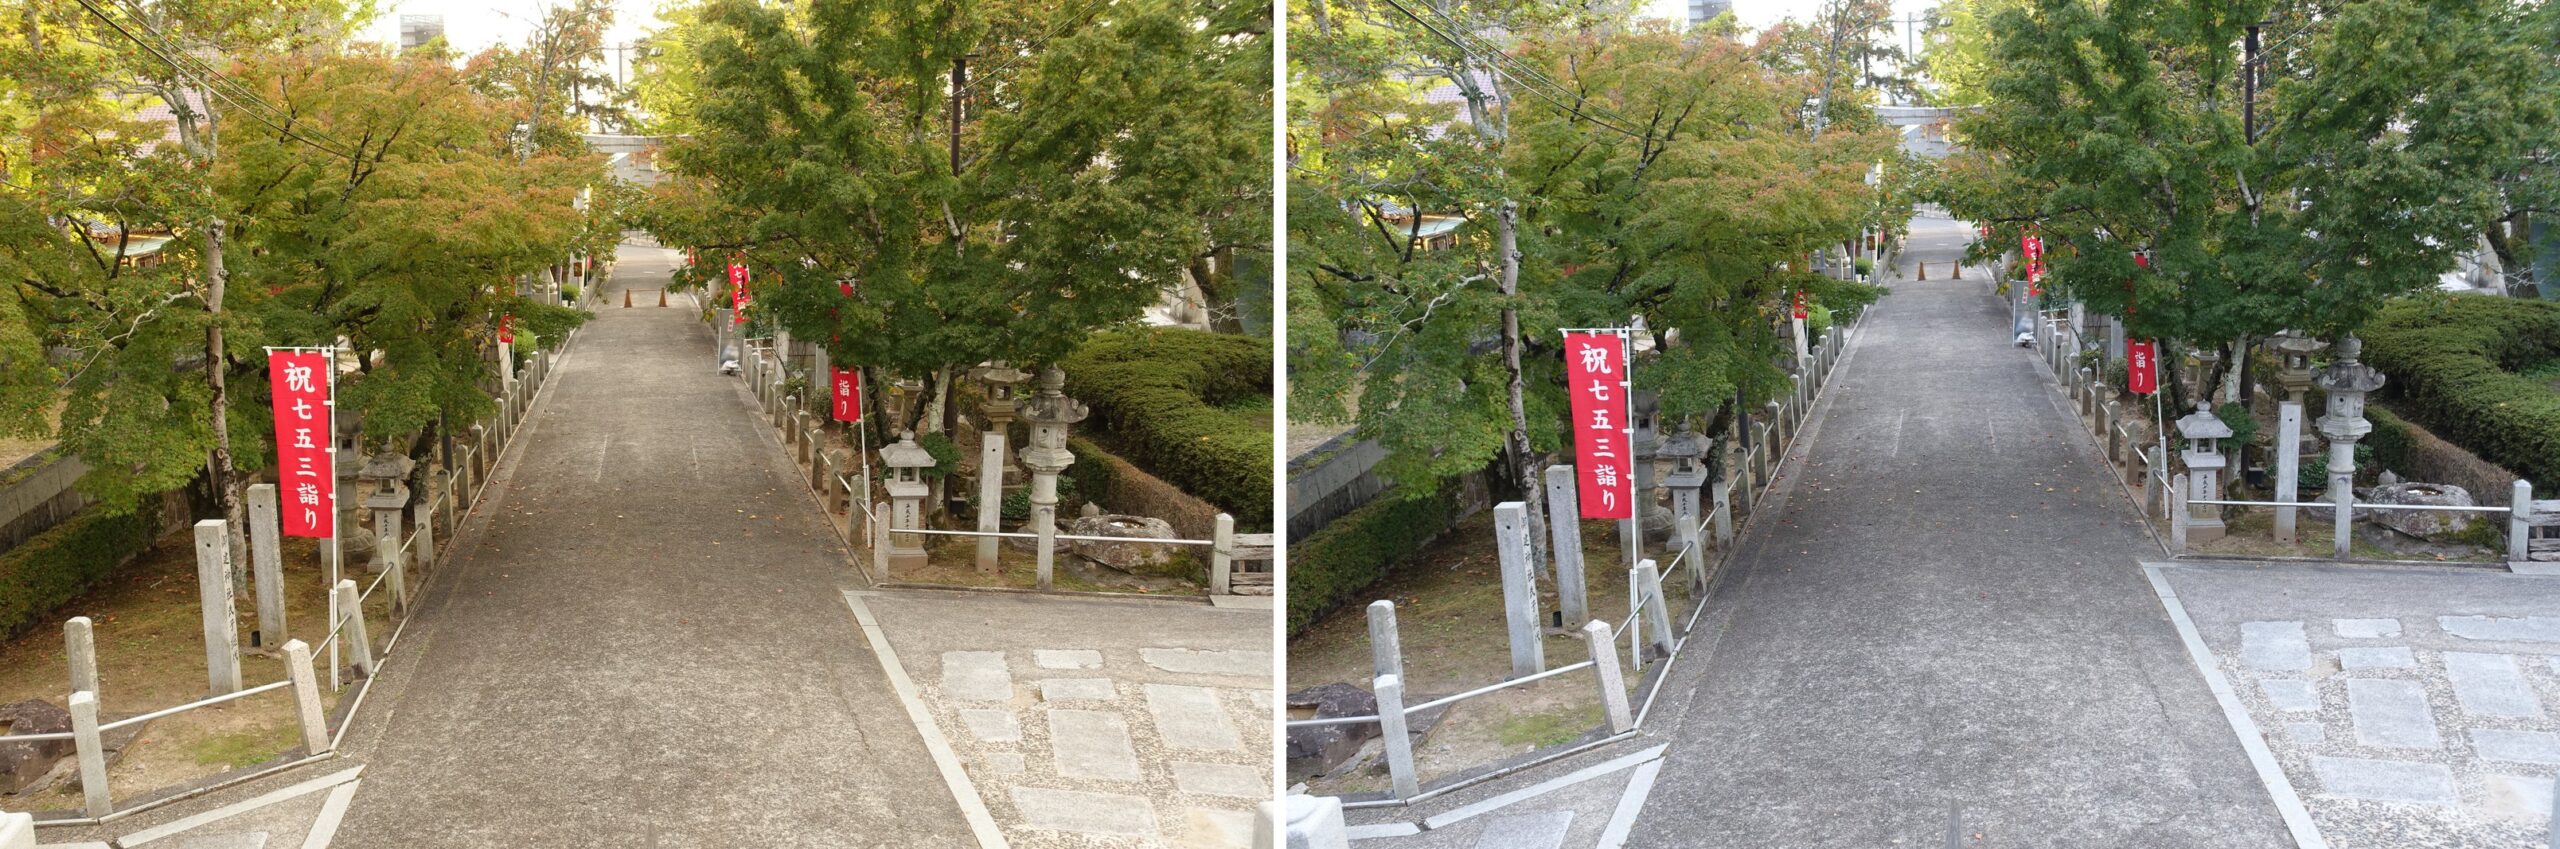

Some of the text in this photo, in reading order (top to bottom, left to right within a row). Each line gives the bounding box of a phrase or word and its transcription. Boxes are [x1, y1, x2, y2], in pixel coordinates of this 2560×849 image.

[283, 361, 319, 530] 祝七五三詣り
[1579, 342, 1617, 511] 祝七五三詣り
